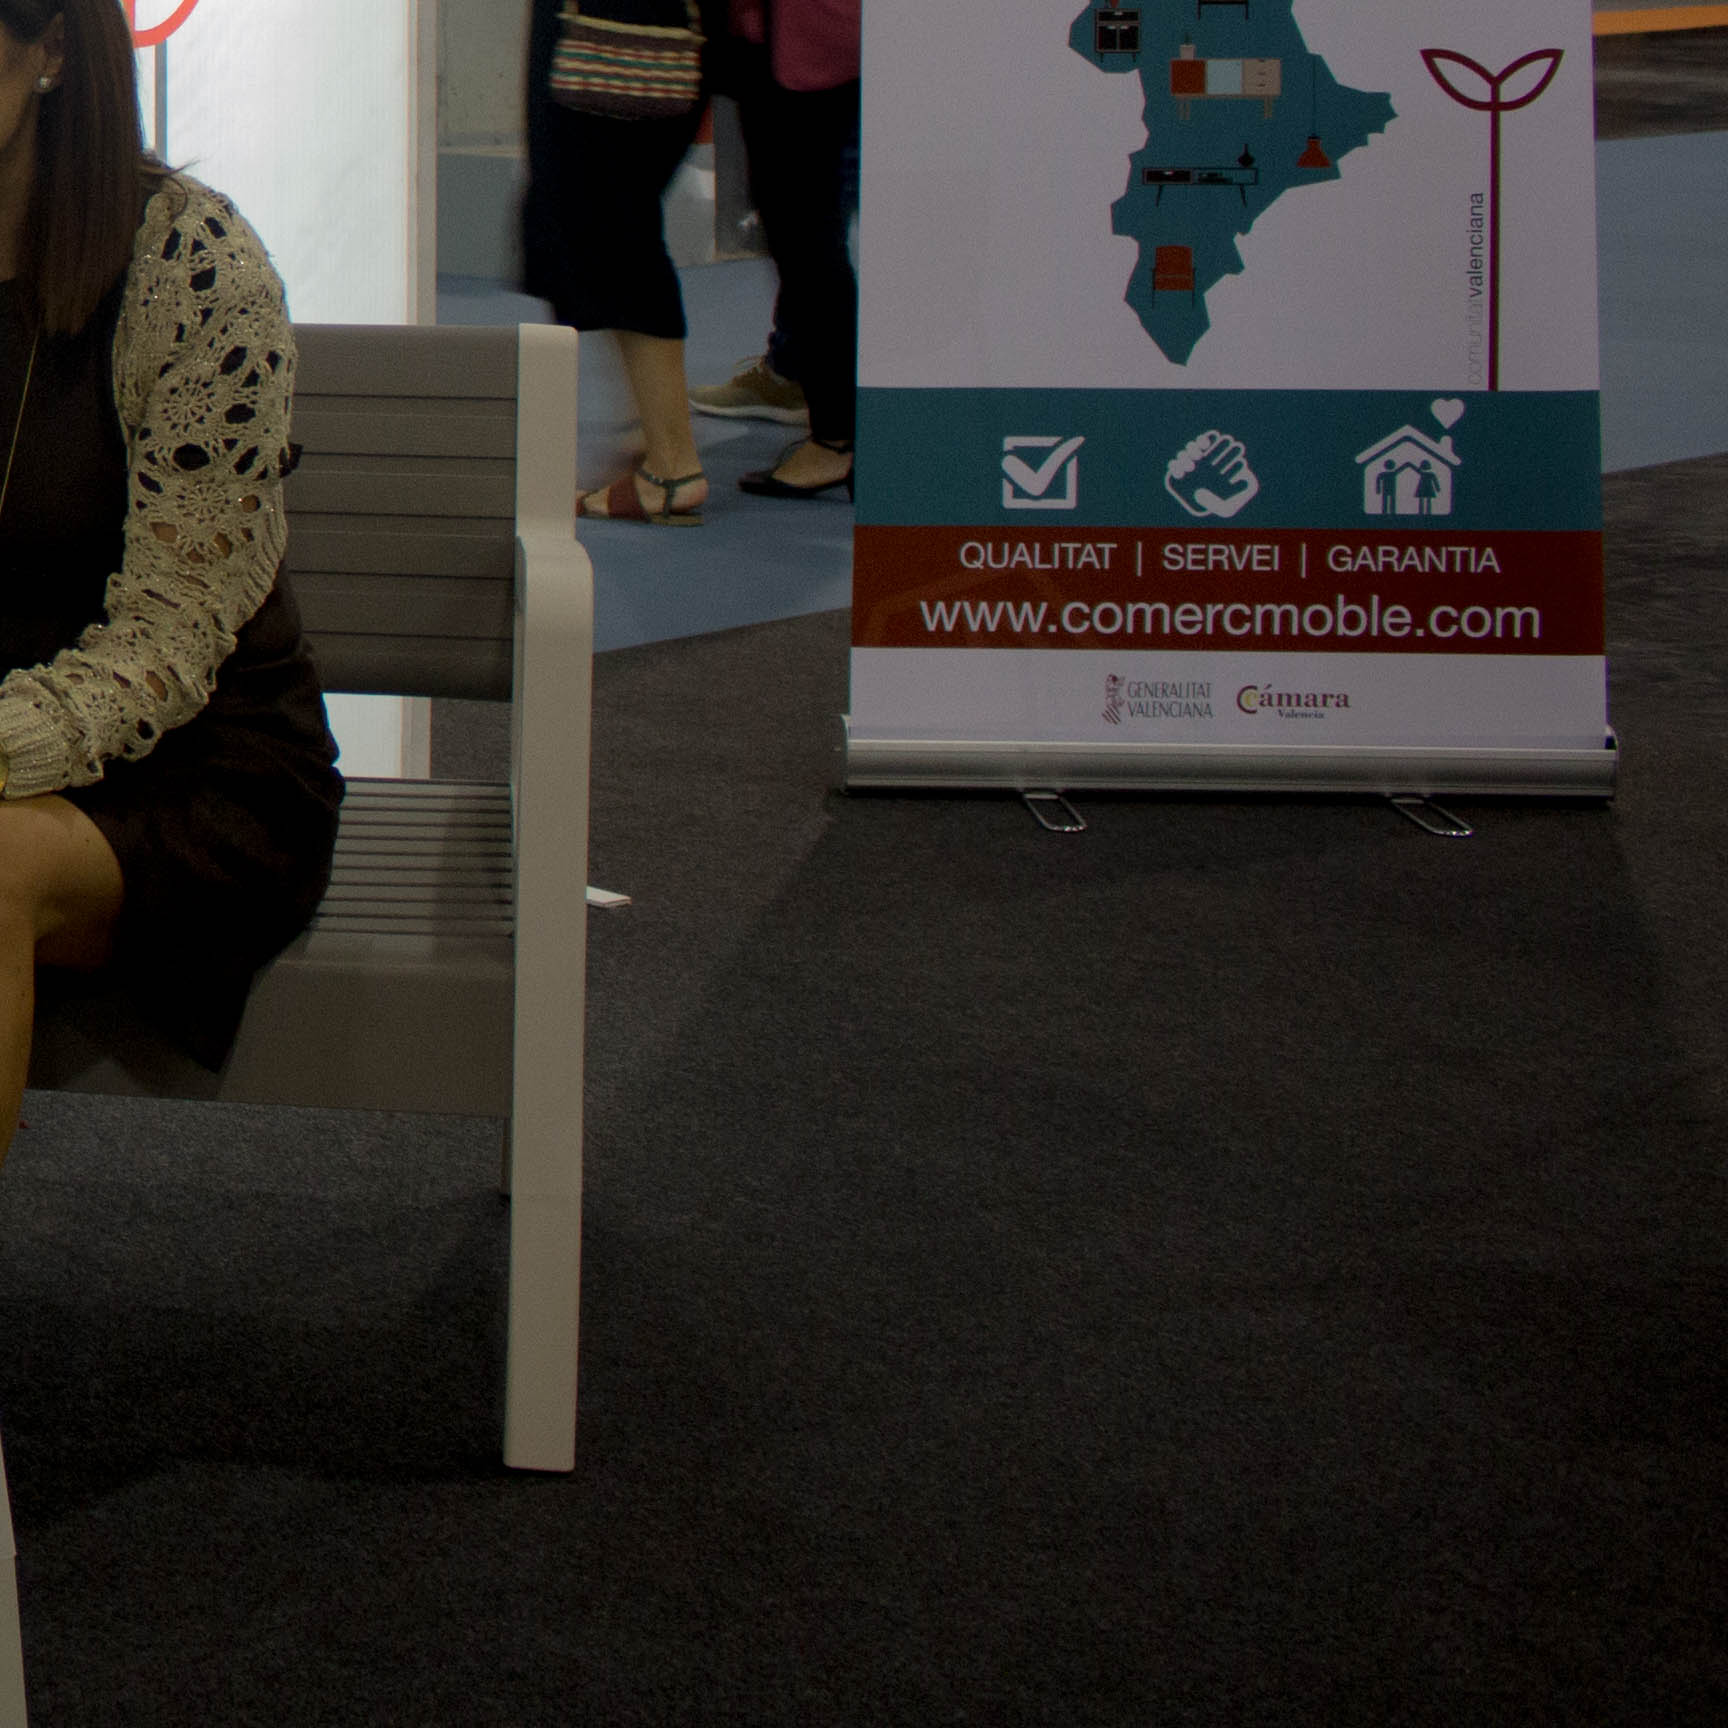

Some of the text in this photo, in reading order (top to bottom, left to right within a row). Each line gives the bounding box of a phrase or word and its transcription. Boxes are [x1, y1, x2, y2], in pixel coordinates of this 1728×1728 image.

[958, 540, 1502, 574] QUALITAT SERVEI GARANTIA
[919, 593, 1542, 640] www.comercmoble.com
[1127, 680, 1214, 700] GENERALITAT
[1236, 683, 1352, 715] Cámara
[1127, 700, 1215, 720] VALENCIANA
